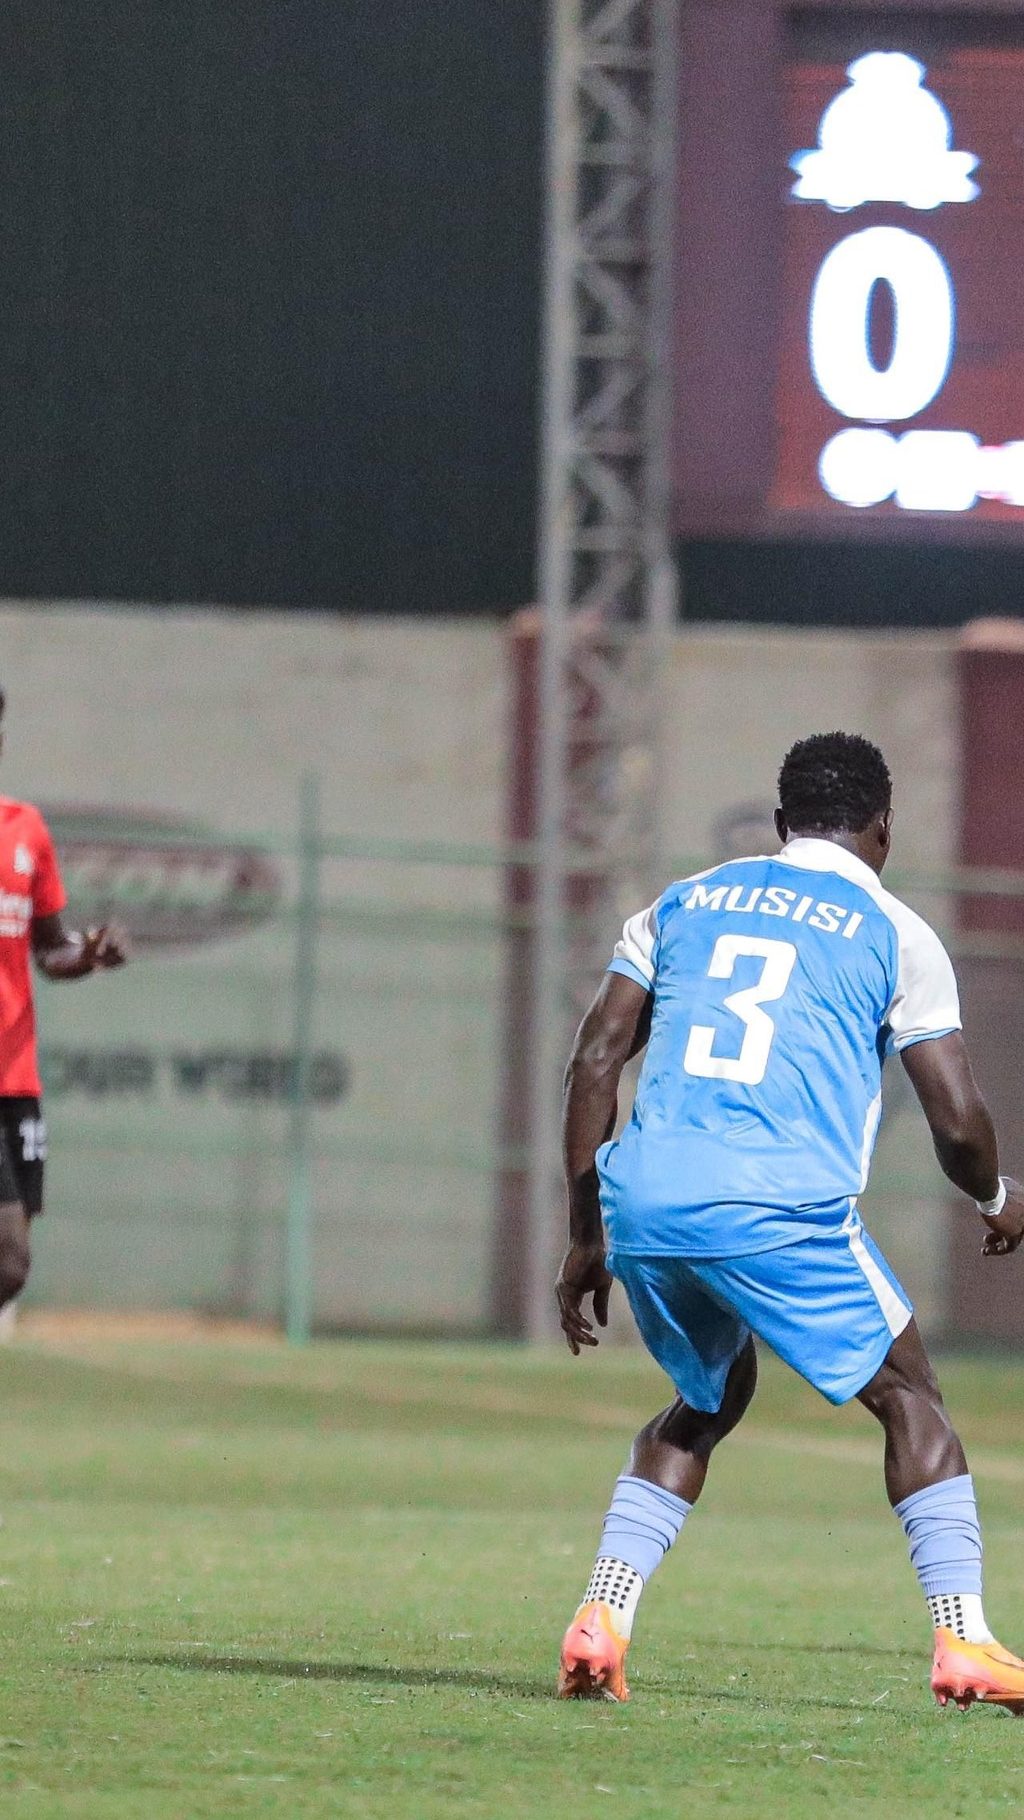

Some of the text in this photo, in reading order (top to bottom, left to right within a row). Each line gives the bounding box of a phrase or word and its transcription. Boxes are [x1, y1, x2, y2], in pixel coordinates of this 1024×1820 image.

[808, 226, 955, 421] 0
[684, 883, 864, 939] MUSISI
[683, 933, 798, 1087] 3
